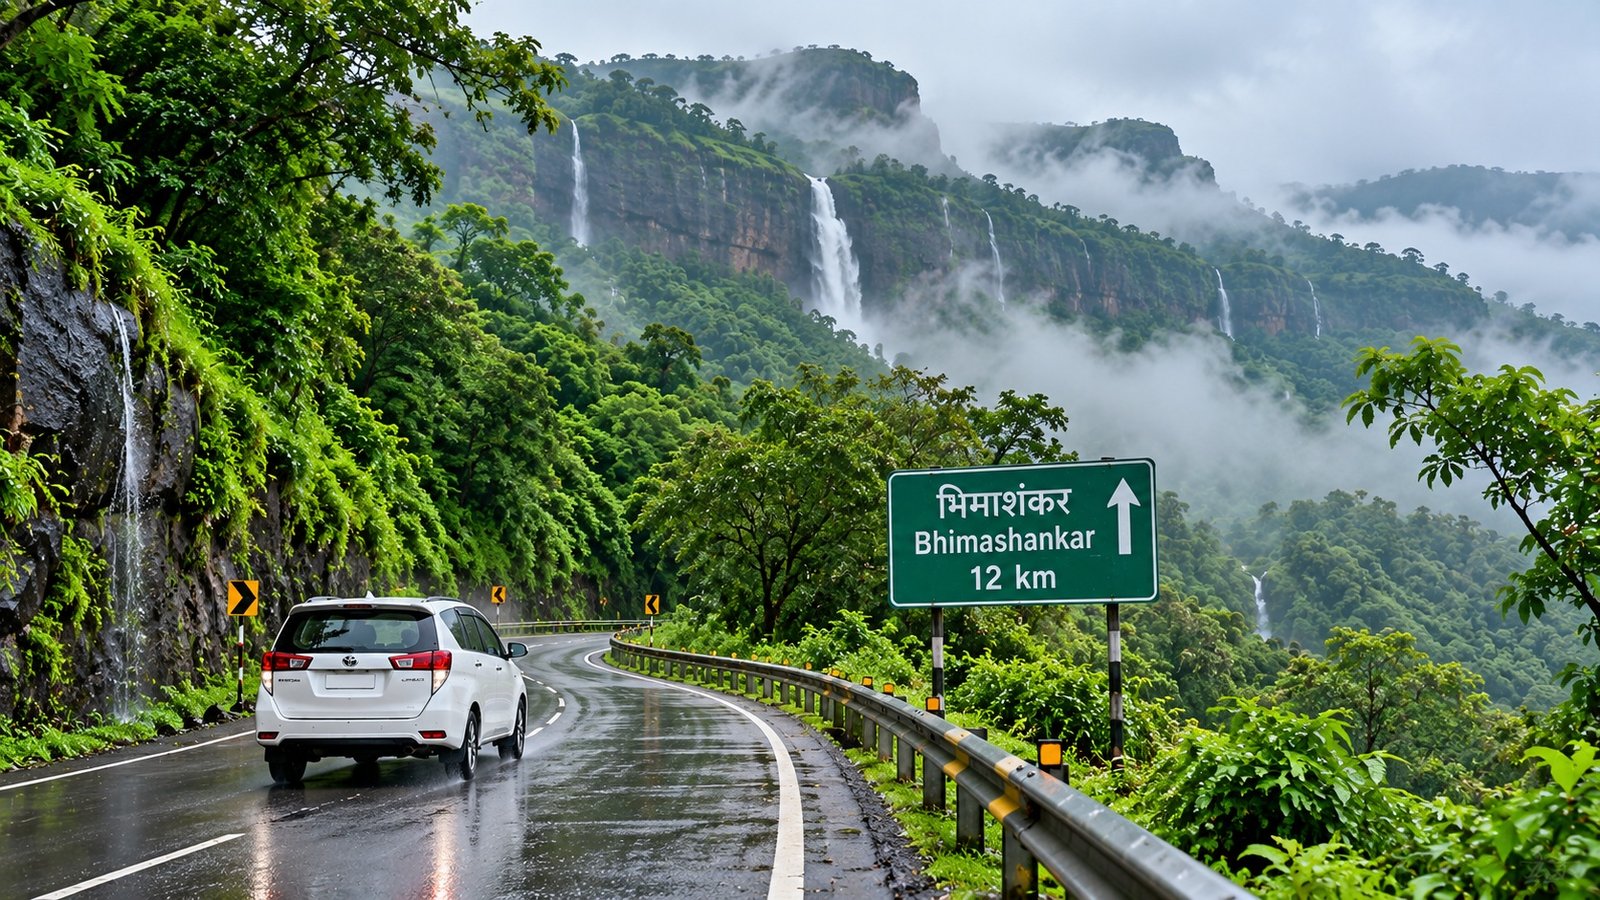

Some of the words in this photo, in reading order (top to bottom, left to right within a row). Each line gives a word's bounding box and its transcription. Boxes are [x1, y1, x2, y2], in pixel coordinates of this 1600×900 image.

[936, 483, 1072, 519] भिमाशंकर
[915, 525, 1095, 555] Bhimashankar
[970, 565, 1002, 590] 12
[1015, 564, 1056, 589] km
